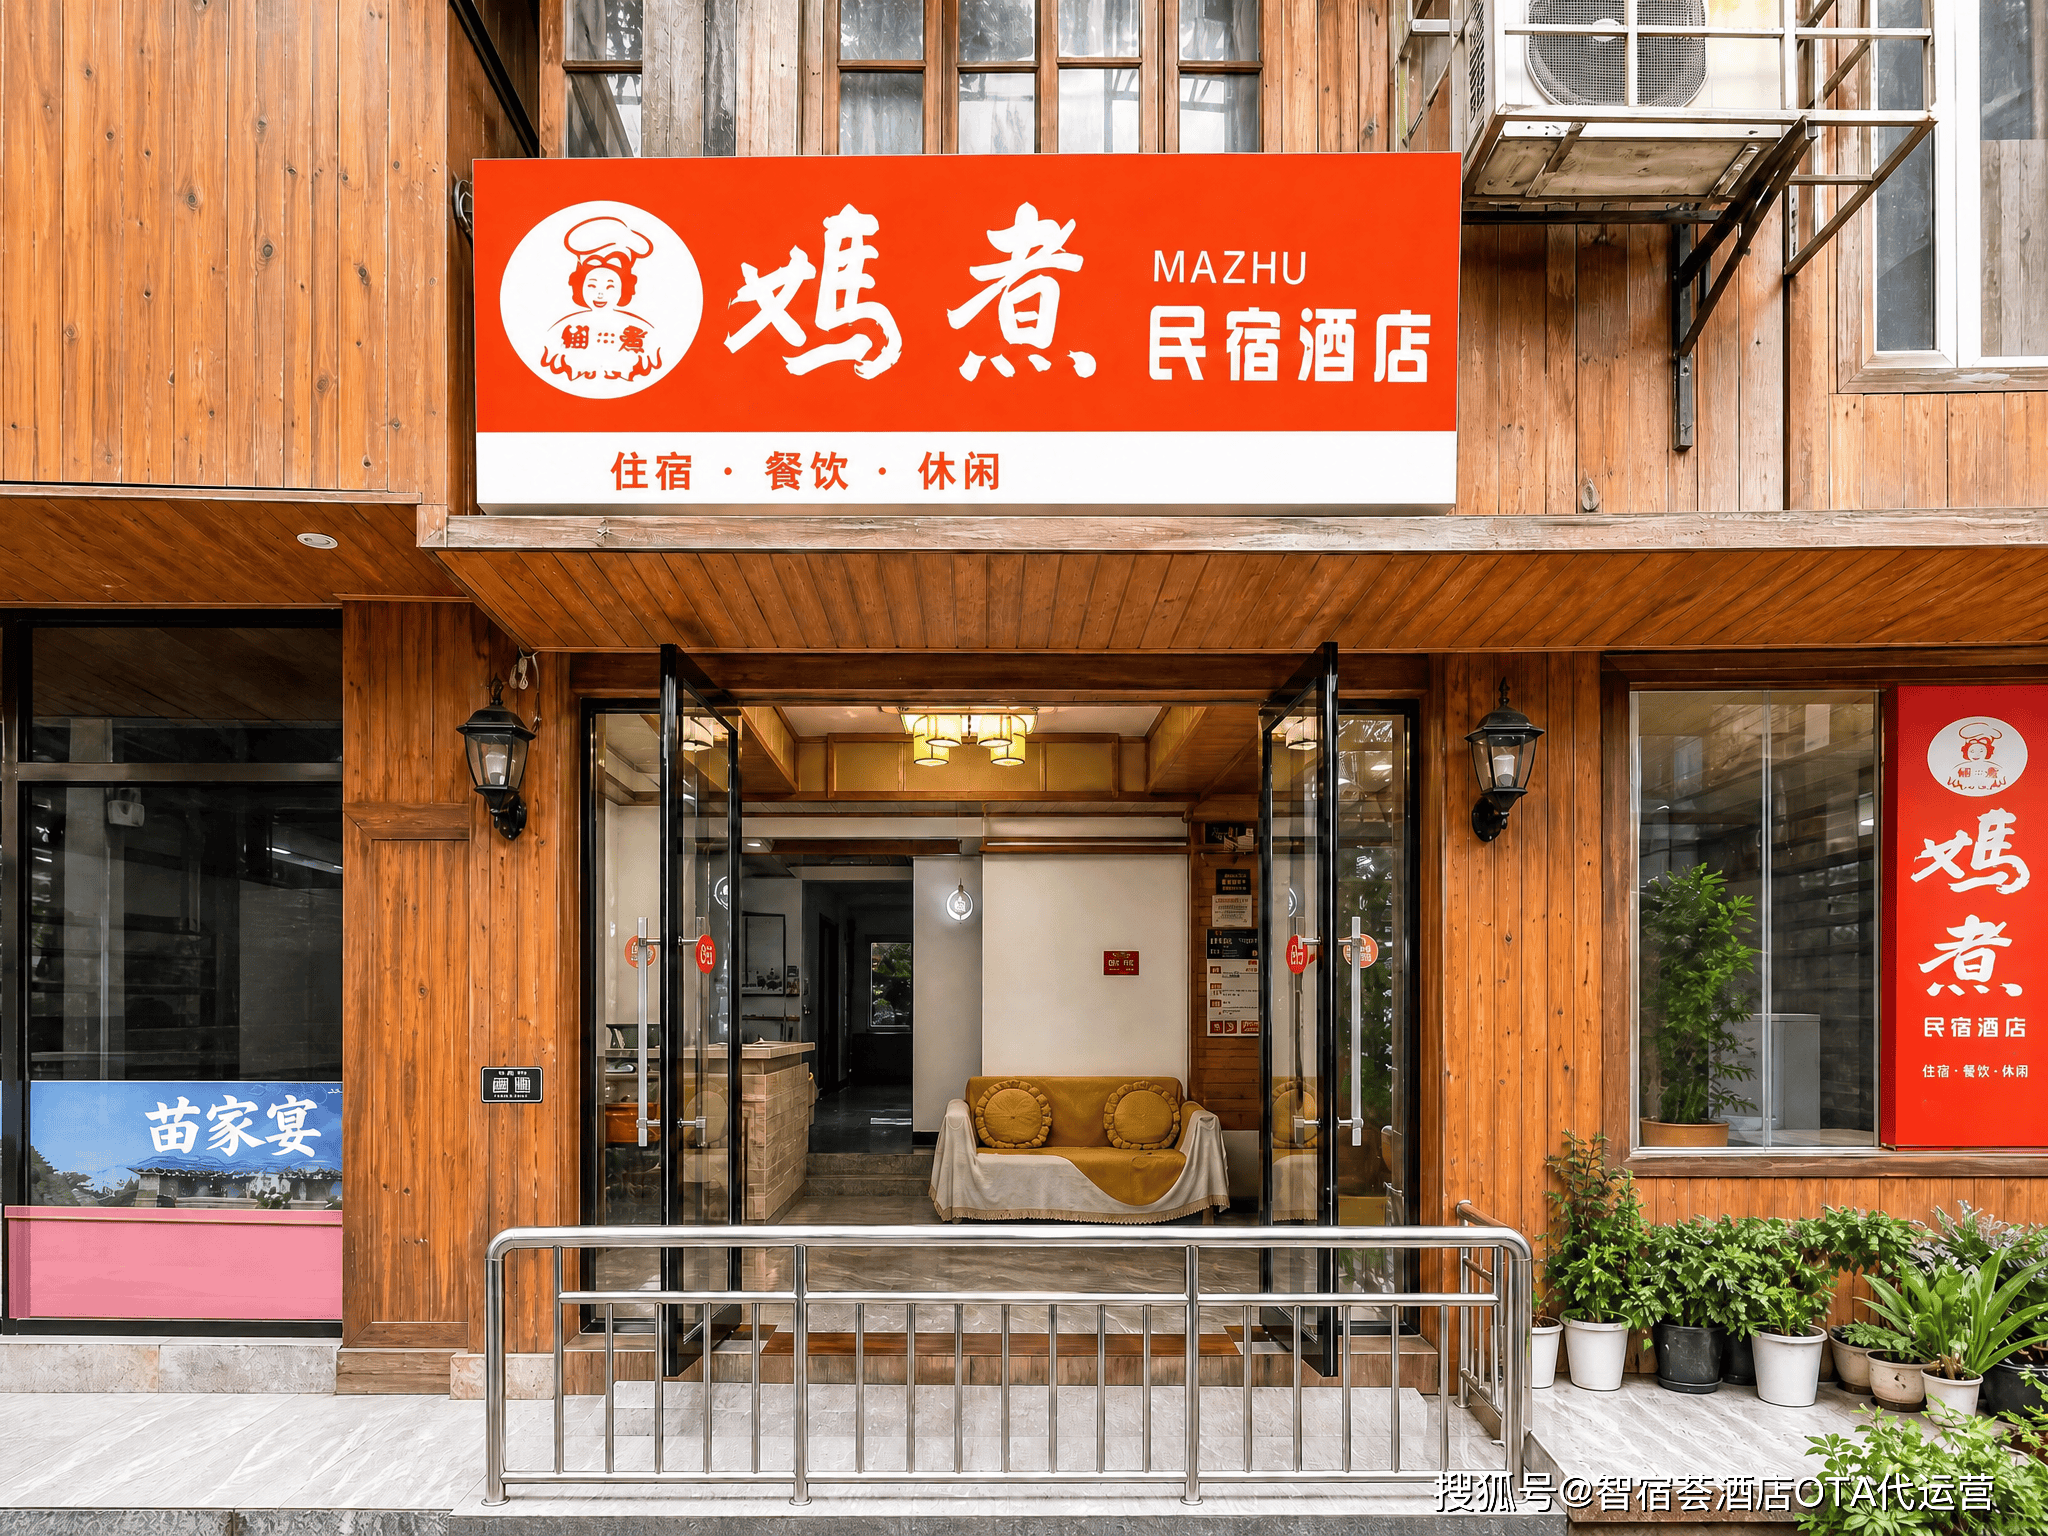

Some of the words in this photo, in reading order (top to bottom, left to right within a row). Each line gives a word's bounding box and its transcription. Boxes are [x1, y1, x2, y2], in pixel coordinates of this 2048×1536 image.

[1153, 249, 1306, 286] MAZHU
[1148, 306, 1431, 383] 民宿酒店
[1924, 1016, 2026, 1038] 民宿酒店
[145, 1094, 322, 1158] 苗家宴
